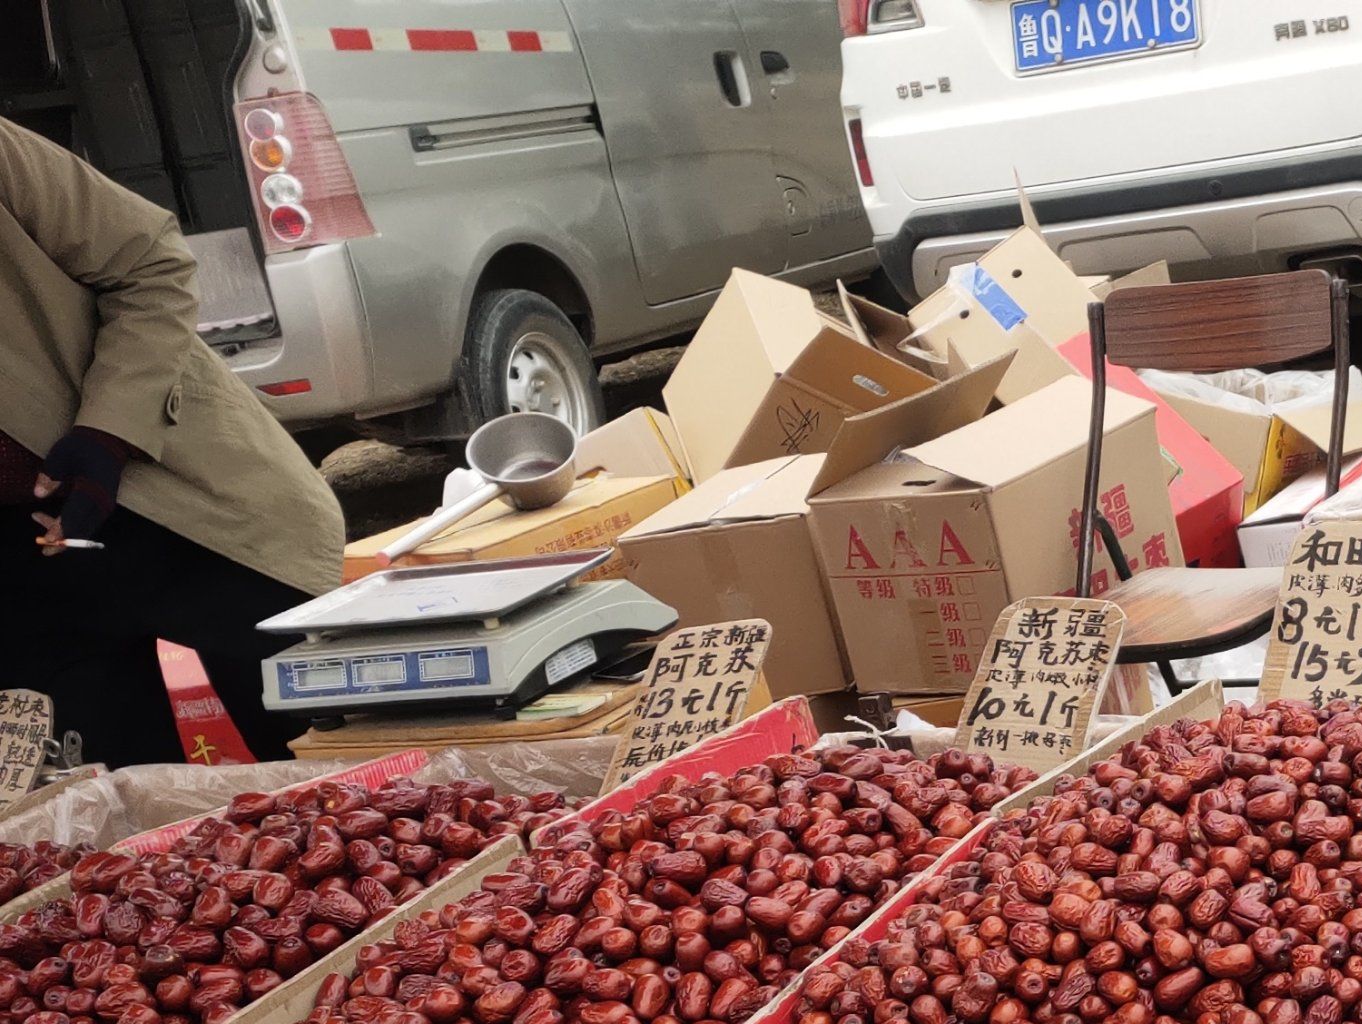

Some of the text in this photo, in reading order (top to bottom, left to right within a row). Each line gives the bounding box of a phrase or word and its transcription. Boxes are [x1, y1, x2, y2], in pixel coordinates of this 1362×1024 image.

[845, 520, 975, 570] AAA
[857, 576, 955, 599] 等级 特级
[920, 602, 960, 623] 一级
[1018, 607, 1110, 640] 新疆
[671, 624, 768, 651] 正宗新疆
[927, 628, 966, 648] 二级
[649, 647, 756, 687] 阿克苏
[932, 653, 972, 674] 三级
[991, 639, 1111, 671] 阿克苏枣
[966, 686, 1079, 729] 10元1斤
